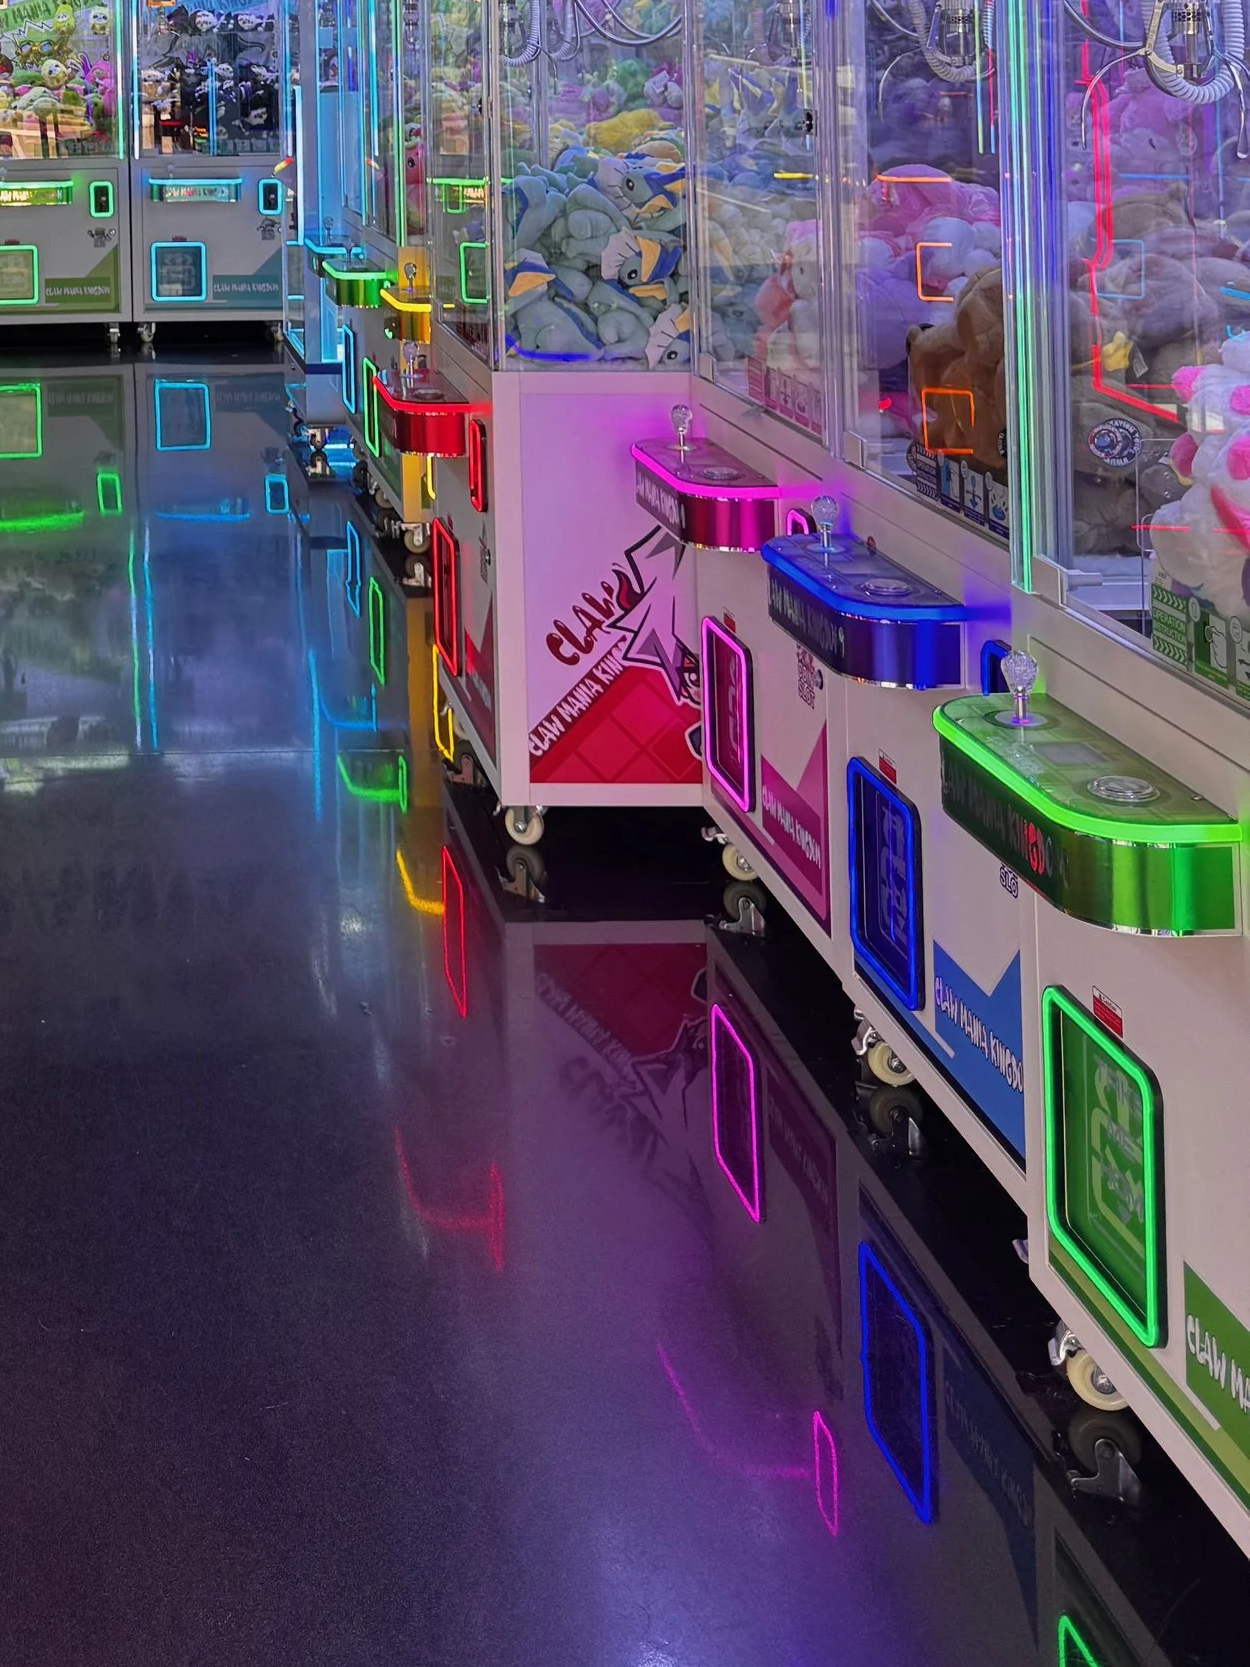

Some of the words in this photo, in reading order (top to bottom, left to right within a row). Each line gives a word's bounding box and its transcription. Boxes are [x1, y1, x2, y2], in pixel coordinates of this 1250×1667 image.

[546, 580, 616, 667] CLAW
[528, 714, 566, 757] CLAW
[556, 677, 605, 724] MANIA
[935, 977, 959, 1025] CLAW
[960, 1002, 989, 1061] MANIA
[1186, 1314, 1227, 1390] CLAW
